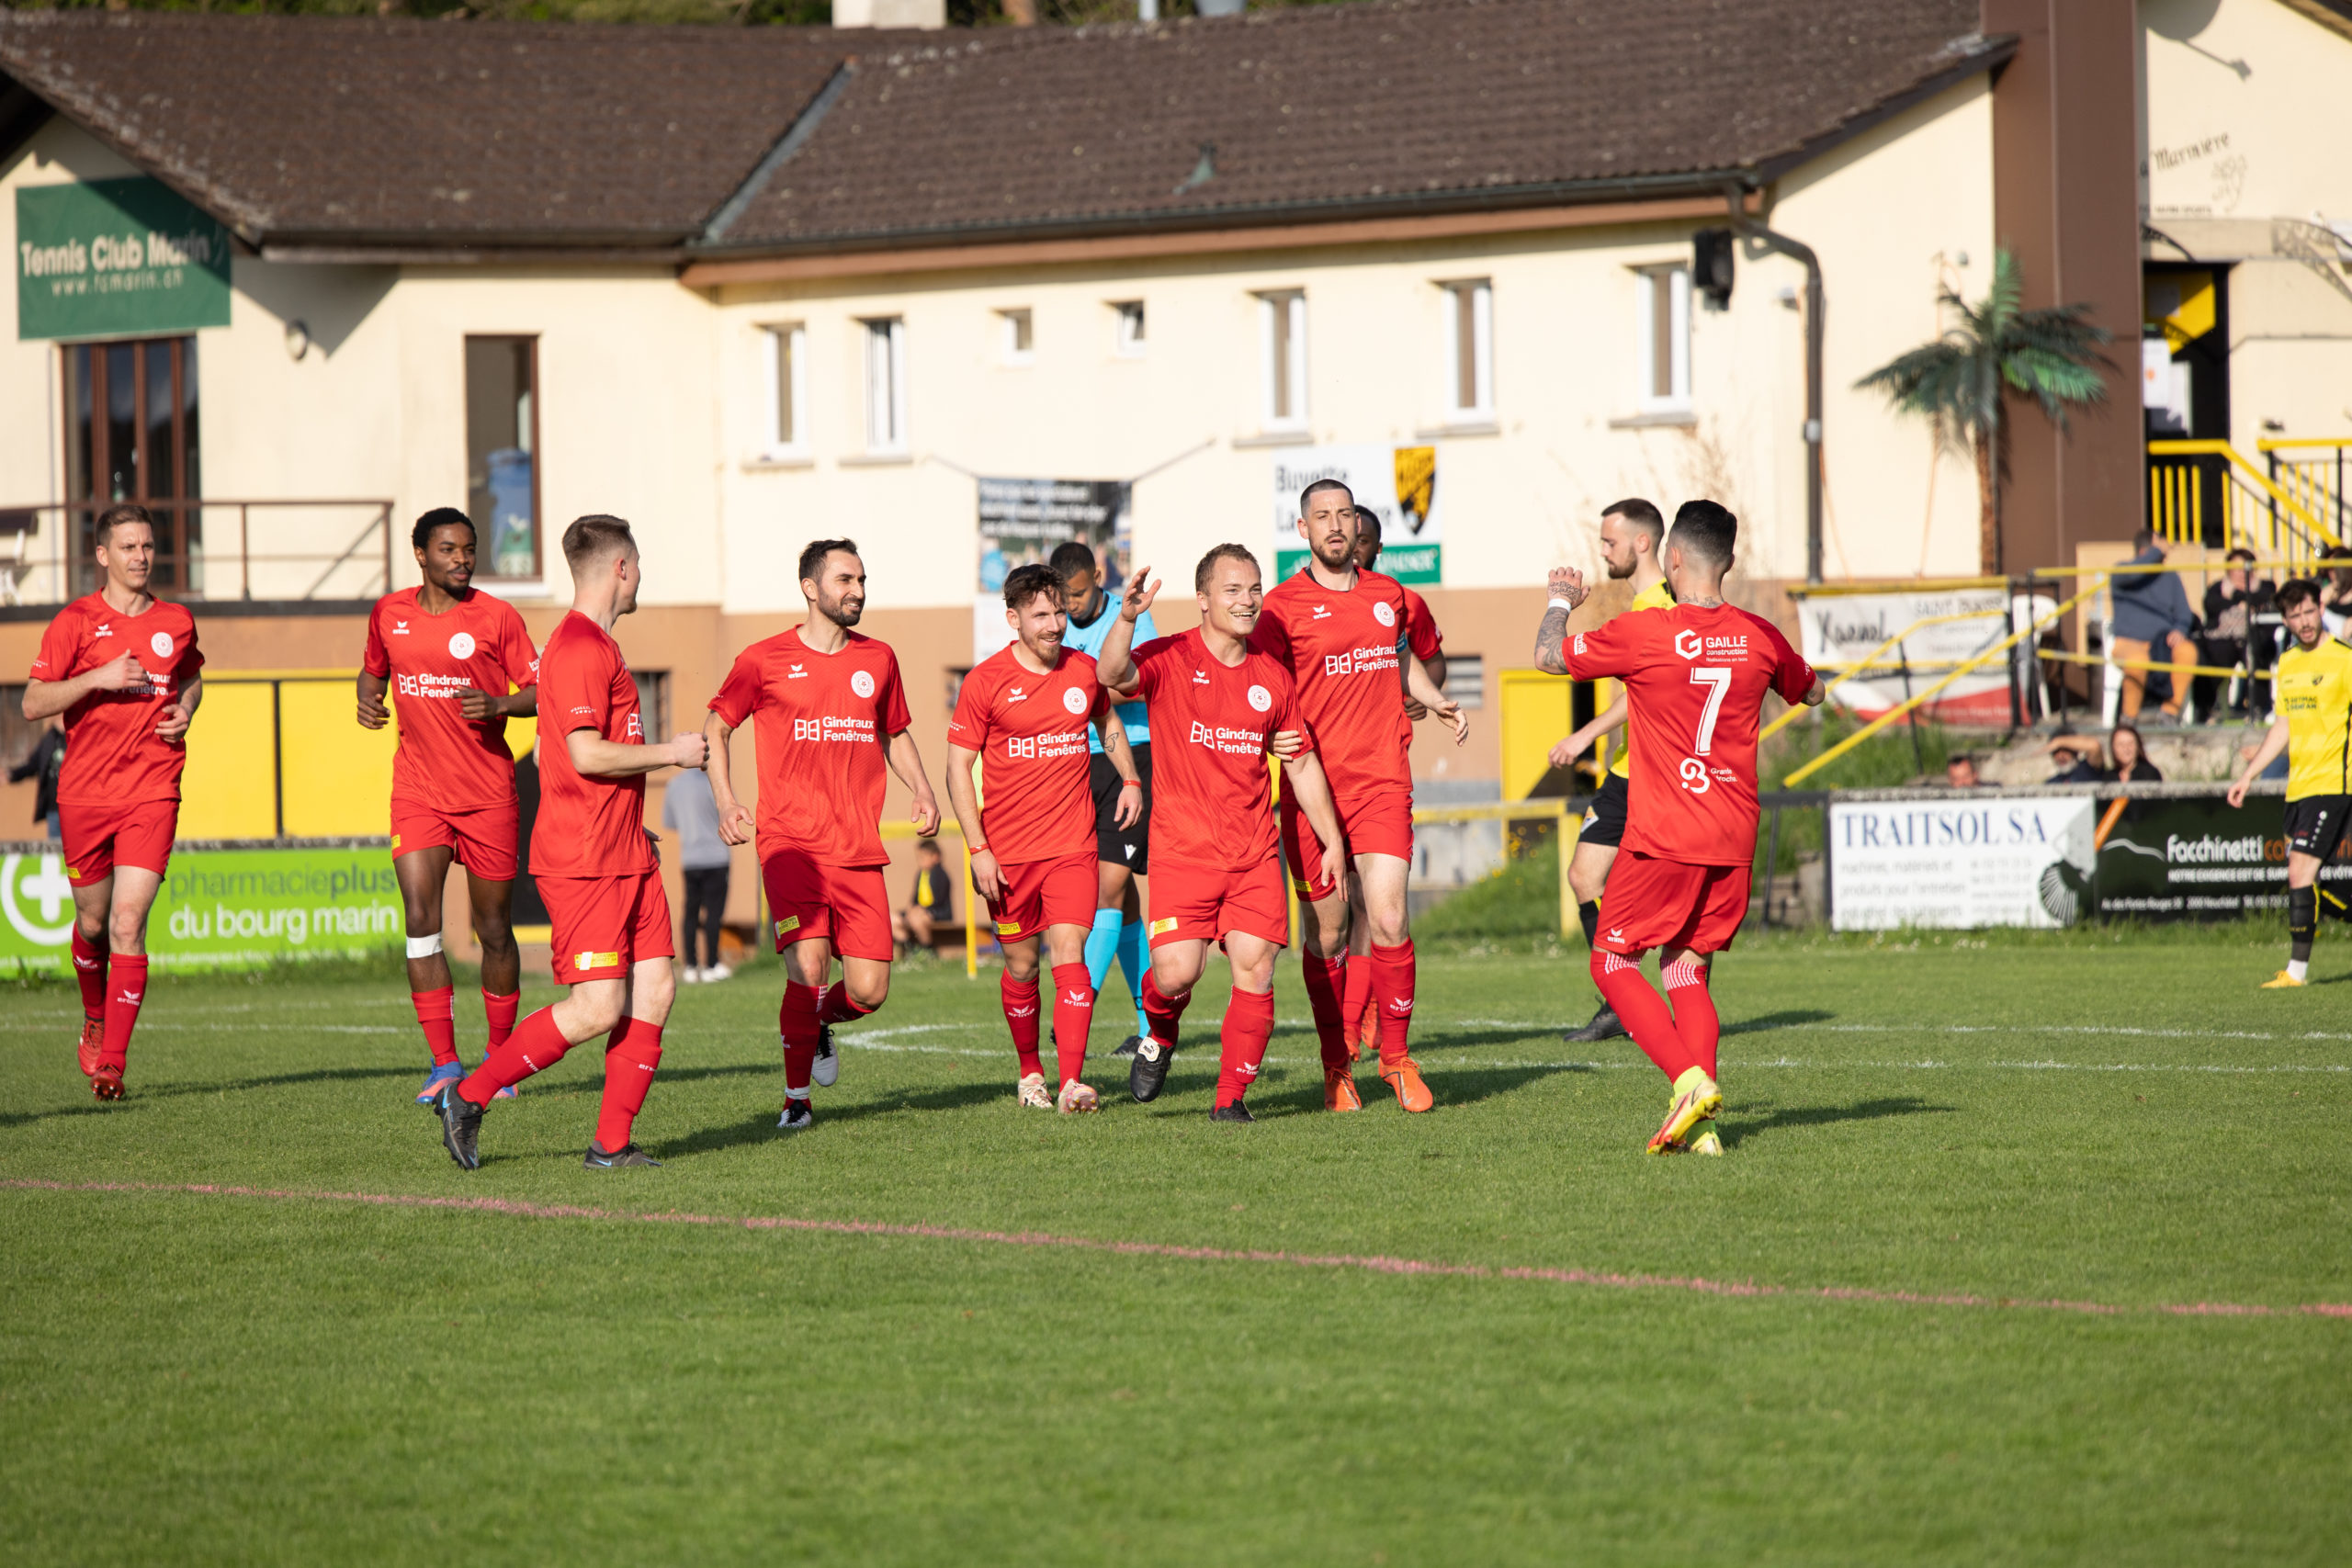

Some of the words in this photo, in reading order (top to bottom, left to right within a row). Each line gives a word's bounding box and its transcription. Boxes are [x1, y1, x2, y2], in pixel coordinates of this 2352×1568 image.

[20, 237, 87, 277] Tennis
[91, 232, 143, 272] Club
[147, 227, 210, 268] Marin
[1705, 636, 1748, 649] GAILLE
[1352, 645, 1397, 660] Gindrau
[1706, 648, 1748, 656] construction
[1354, 658, 1399, 673] Fenêtres
[419, 673, 471, 686] Gindraux
[1690, 667, 1732, 756] 7
[822, 716, 875, 729] Gindraux
[823, 729, 875, 743] Fenêtres
[1216, 728, 1263, 742] Gindrau
[1038, 744, 1086, 759] Fenêtres
[1216, 740, 1262, 756] Fenêtre
[1840, 807, 1999, 848] TRAITSOL
[2007, 807, 2047, 846] SA
[2167, 833, 2264, 863] facchinetti
[169, 862, 397, 905] pharmacieplus
[169, 903, 210, 941] du
[216, 901, 308, 945] bourg
[313, 897, 399, 935] marin
[117, 996, 140, 1007] erima
[1064, 998, 1091, 1008] erima
